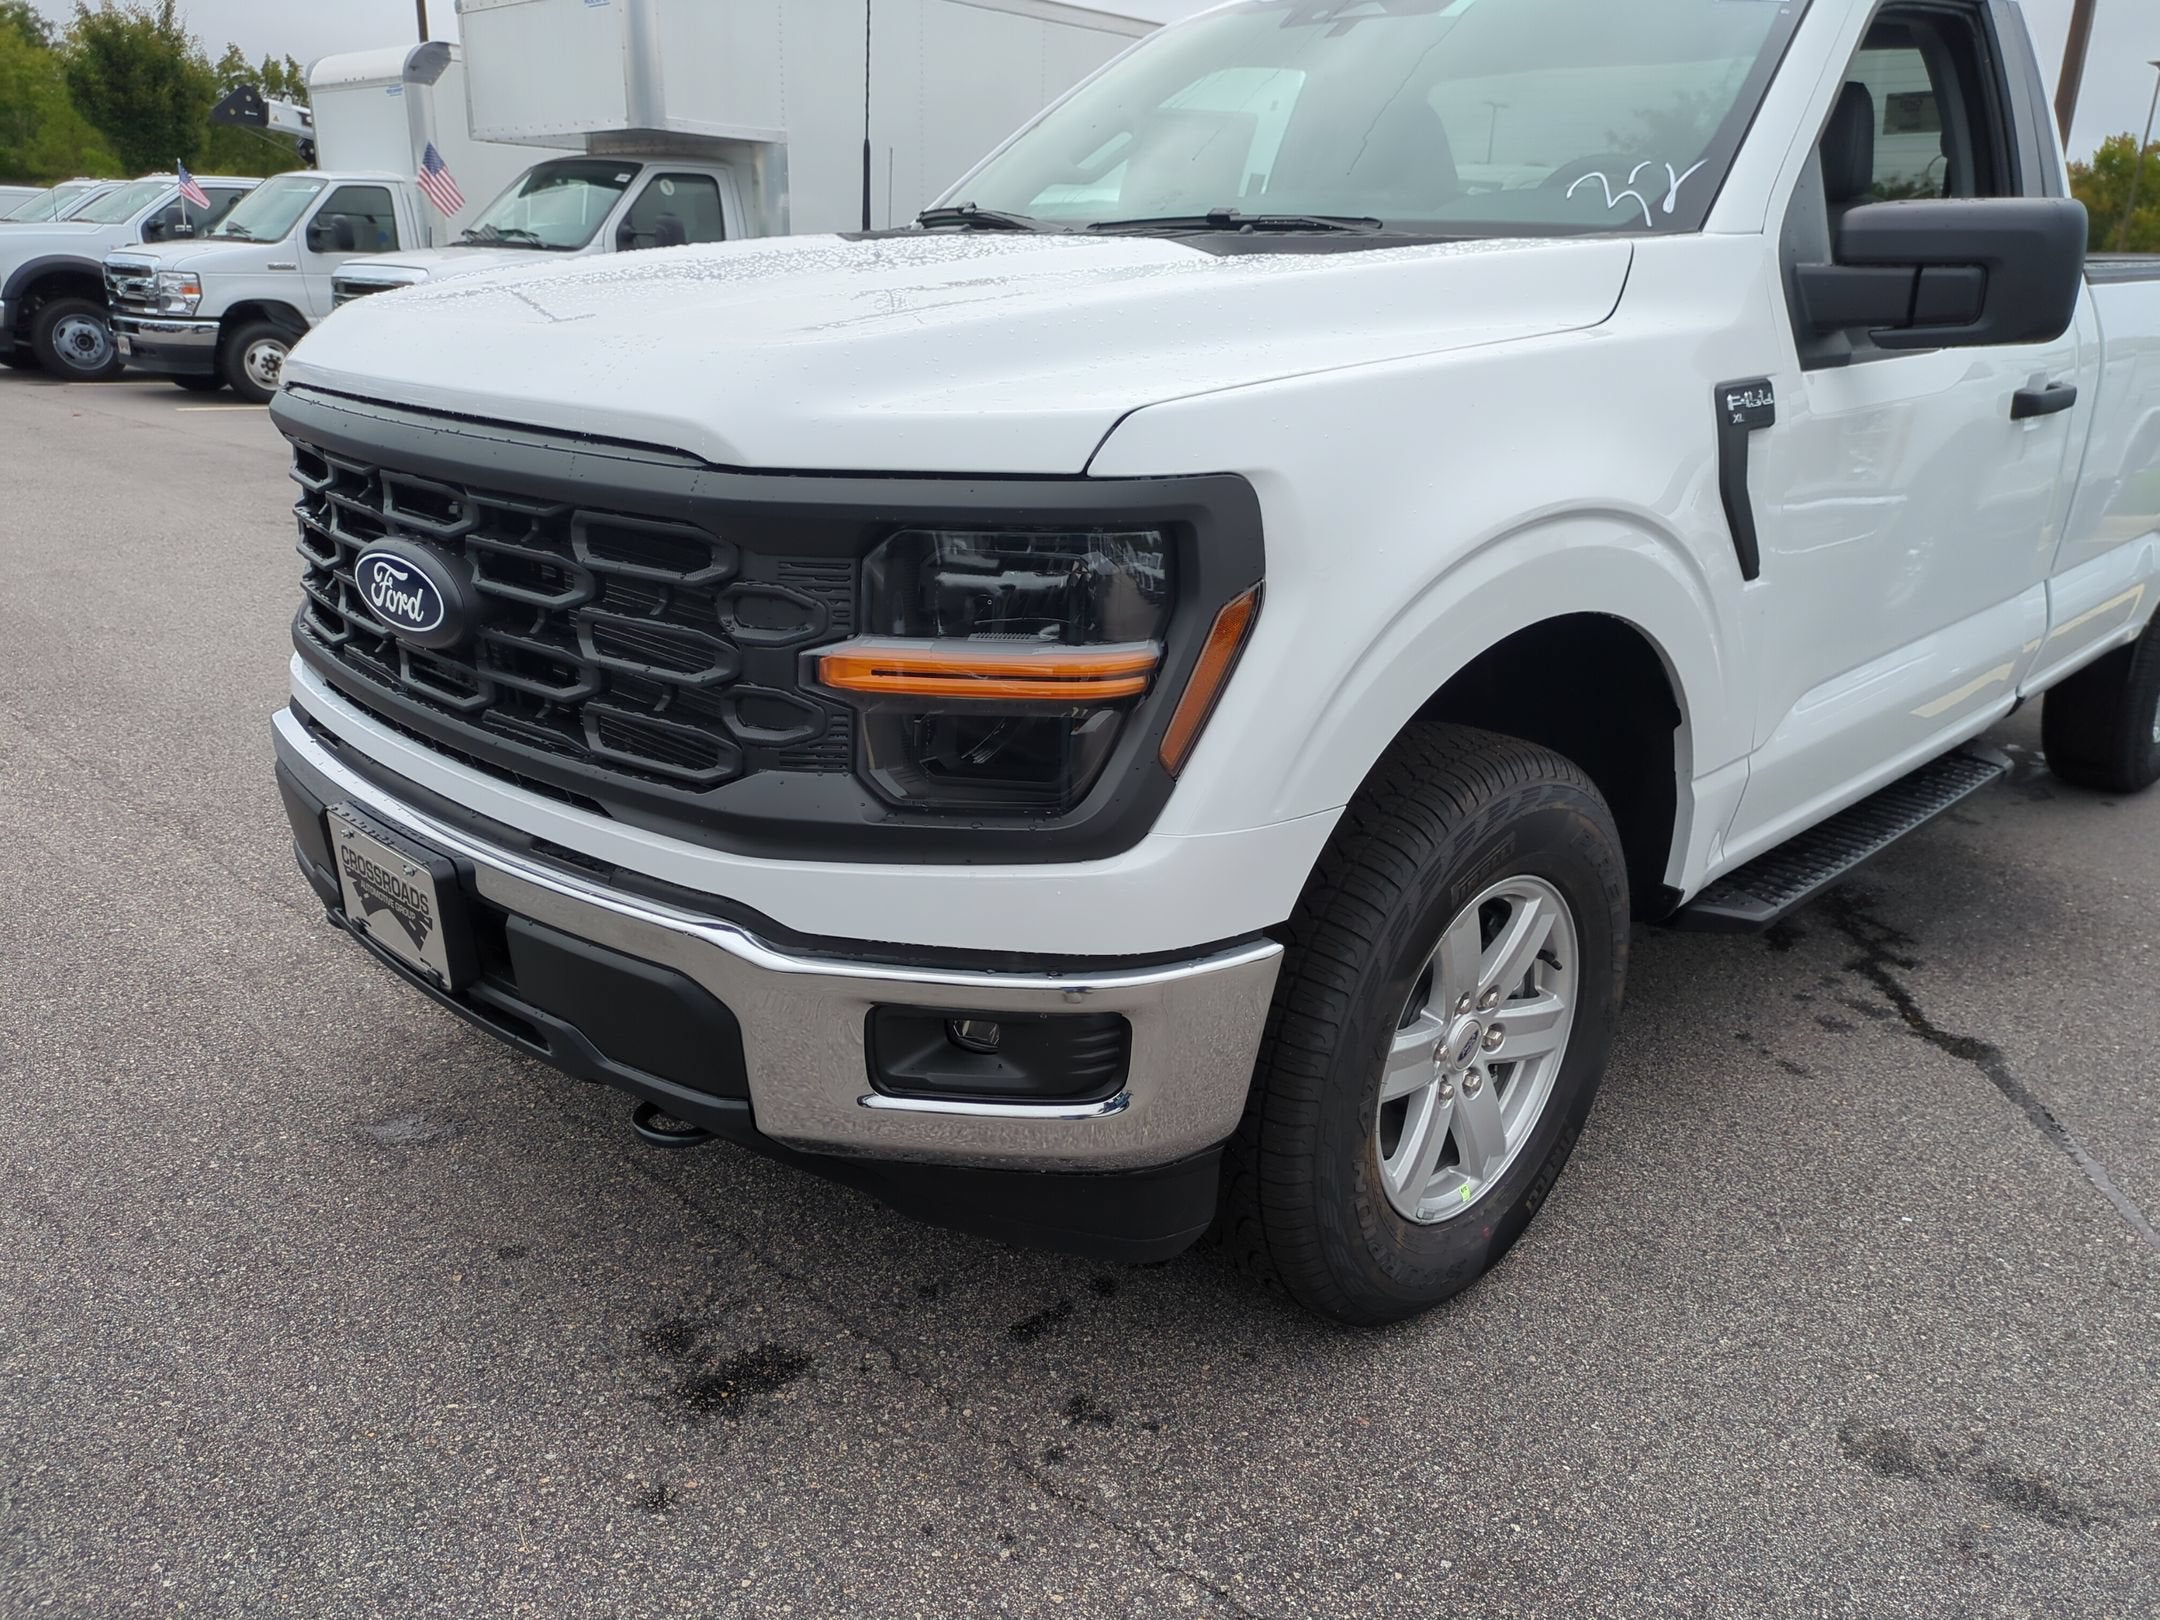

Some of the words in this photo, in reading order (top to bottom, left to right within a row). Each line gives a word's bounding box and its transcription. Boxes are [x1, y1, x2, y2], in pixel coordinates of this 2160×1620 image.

[371, 561, 424, 622] Ford
[340, 844, 430, 916] CROSSROADS
[360, 879, 396, 909] AUTOMOTIVE
[395, 901, 417, 921] GROUP
